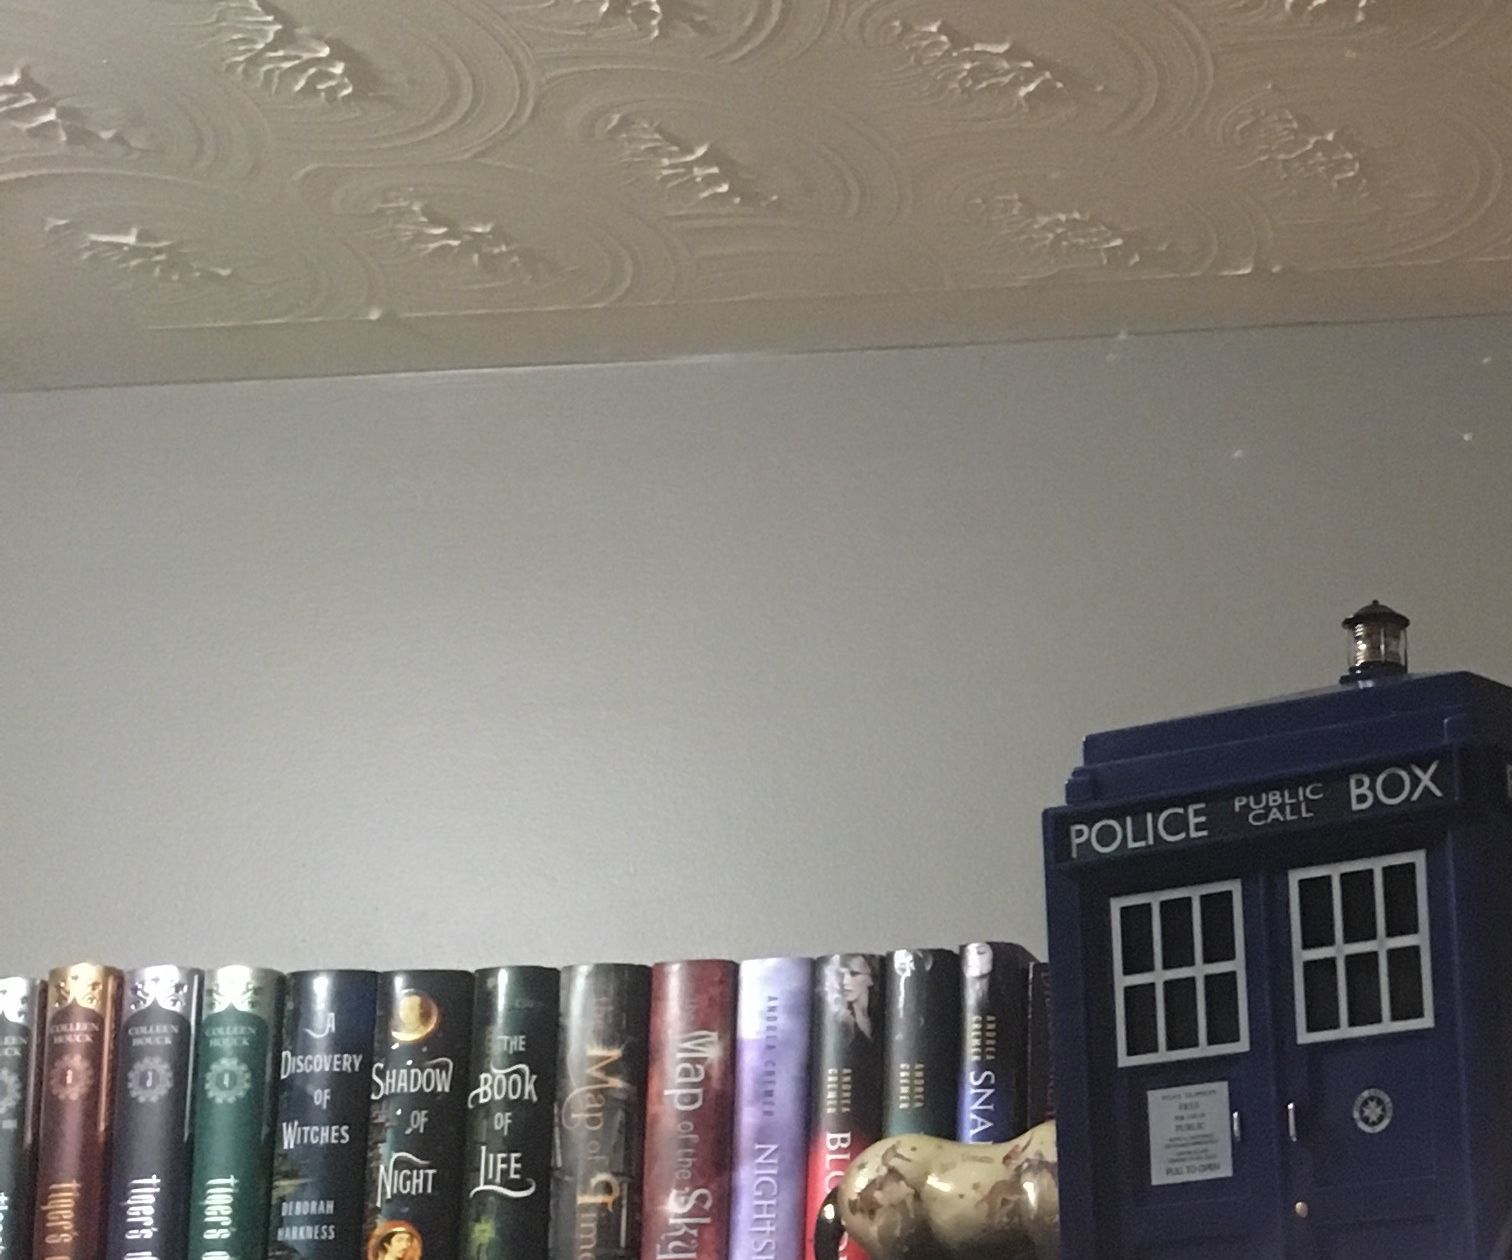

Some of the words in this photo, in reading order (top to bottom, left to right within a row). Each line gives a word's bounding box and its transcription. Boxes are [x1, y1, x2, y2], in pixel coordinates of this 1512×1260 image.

[1069, 803, 1209, 859] POLICE
[1234, 782, 1324, 813] PUBLIC
[1349, 760, 1443, 812] BOX
[1248, 801, 1314, 826] CALL
[127, 1025, 179, 1036] COLLEEN
[131, 1036, 172, 1047] HOUCK
[497, 1035, 527, 1055] THE
[280, 1051, 363, 1080] DISCOVERY
[663, 1030, 720, 1112] Map
[371, 1057, 454, 1101] SHADOW
[468, 1060, 540, 1110] BOOK
[313, 1088, 331, 1110] OF
[281, 1119, 350, 1150] WITCHES
[405, 1110, 429, 1135] OF
[493, 1112, 513, 1136] OF
[376, 1152, 438, 1208] NIGHT
[469, 1145, 537, 1199] LIFE
[281, 1200, 335, 1217] DEBORAH
[277, 1224, 336, 1241] HARKNESS
